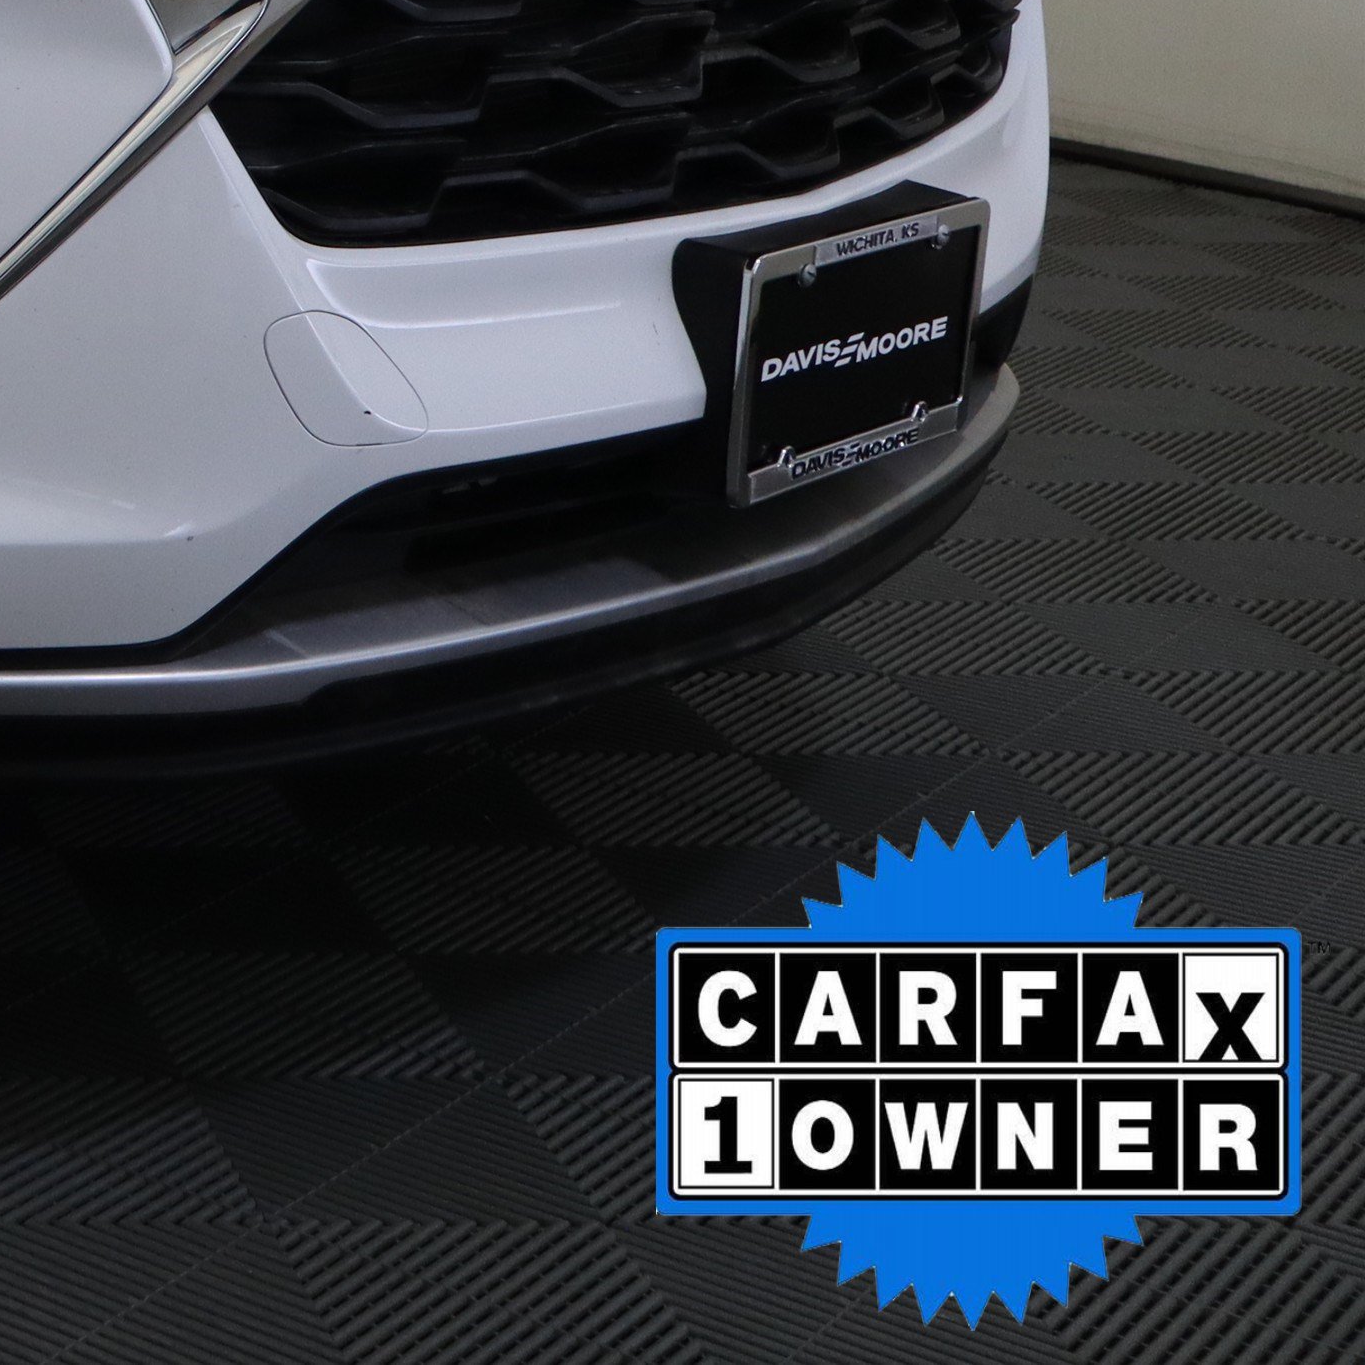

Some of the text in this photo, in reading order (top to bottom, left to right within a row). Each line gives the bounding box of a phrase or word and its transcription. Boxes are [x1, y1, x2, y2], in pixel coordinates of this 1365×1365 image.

[902, 223, 919, 239] KS
[761, 316, 948, 382] DAVIS MOORE
[792, 429, 919, 480] DAVIS MOORE
